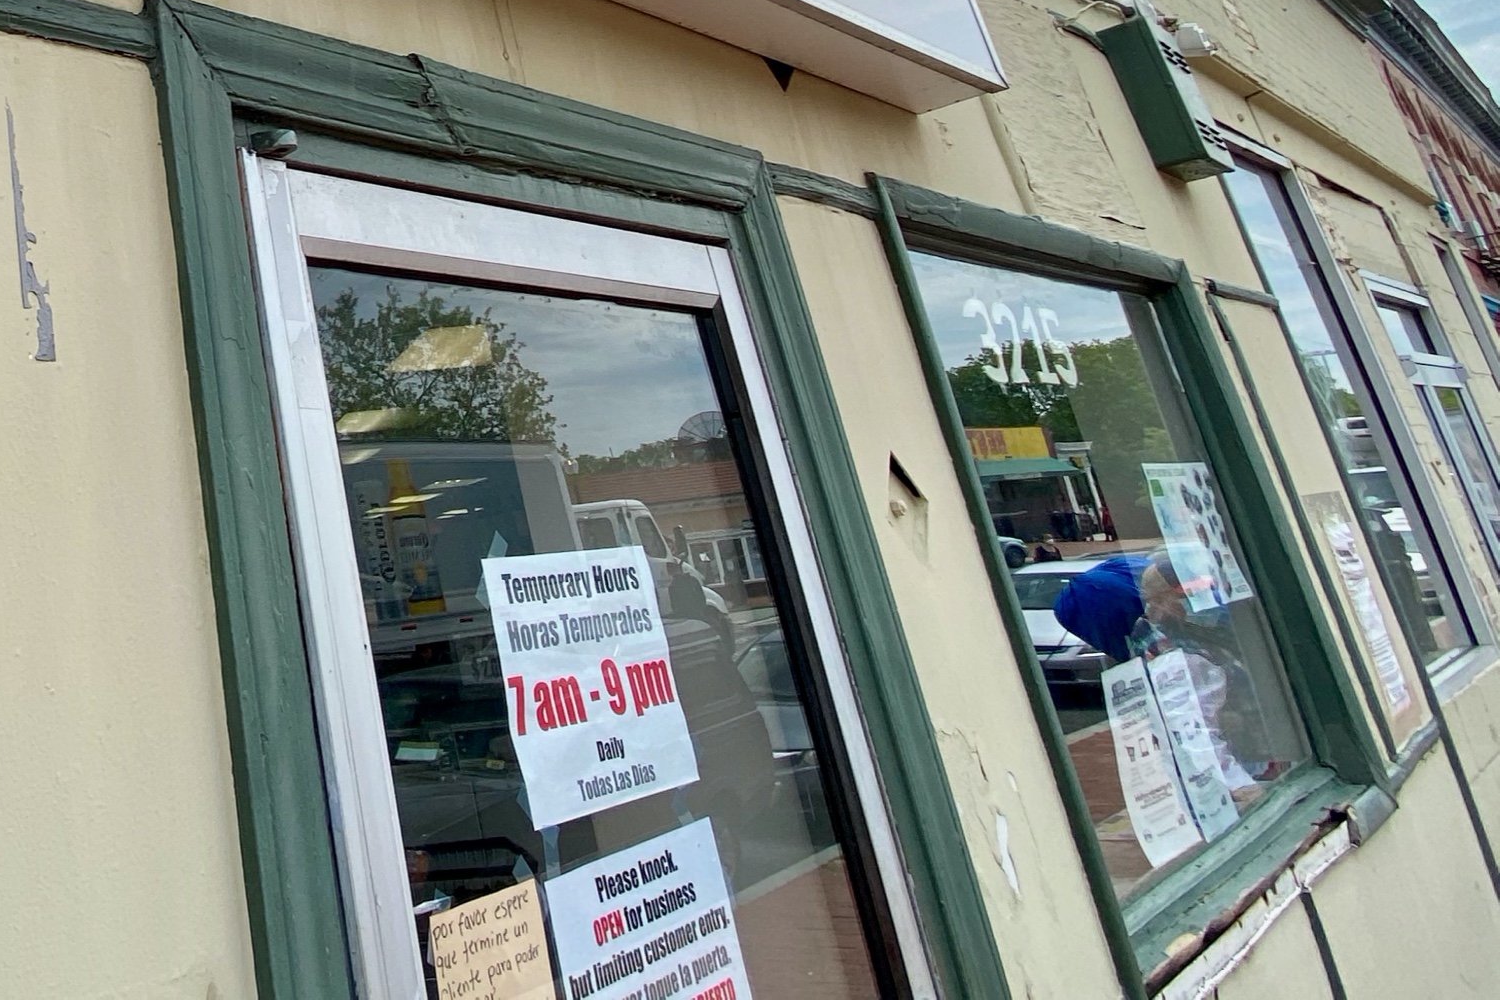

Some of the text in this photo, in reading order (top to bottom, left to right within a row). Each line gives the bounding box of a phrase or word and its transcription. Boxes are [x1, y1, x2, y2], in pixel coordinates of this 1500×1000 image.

[963, 298, 1079, 389] 3215
[501, 565, 640, 604] Temporary Hours
[506, 605, 653, 652] Horas Temporales
[507, 658, 675, 736] 7 am - 9 pm
[596, 737, 626, 762] Daily
[577, 763, 656, 801] Todas Las Dias
[594, 849, 679, 903] Please knock.
[433, 889, 529, 950] por favor espere
[593, 882, 697, 946] OPEN for business
[436, 921, 529, 978] que termine un
[441, 968, 482, 1000] cliente
[487, 958, 513, 986] para
[515, 943, 540, 973] poder
[568, 905, 730, 1000] but limiting customer entry.
[643, 974, 679, 1000] toque
[678, 963, 694, 989] la
[692, 944, 732, 985] puerta.
